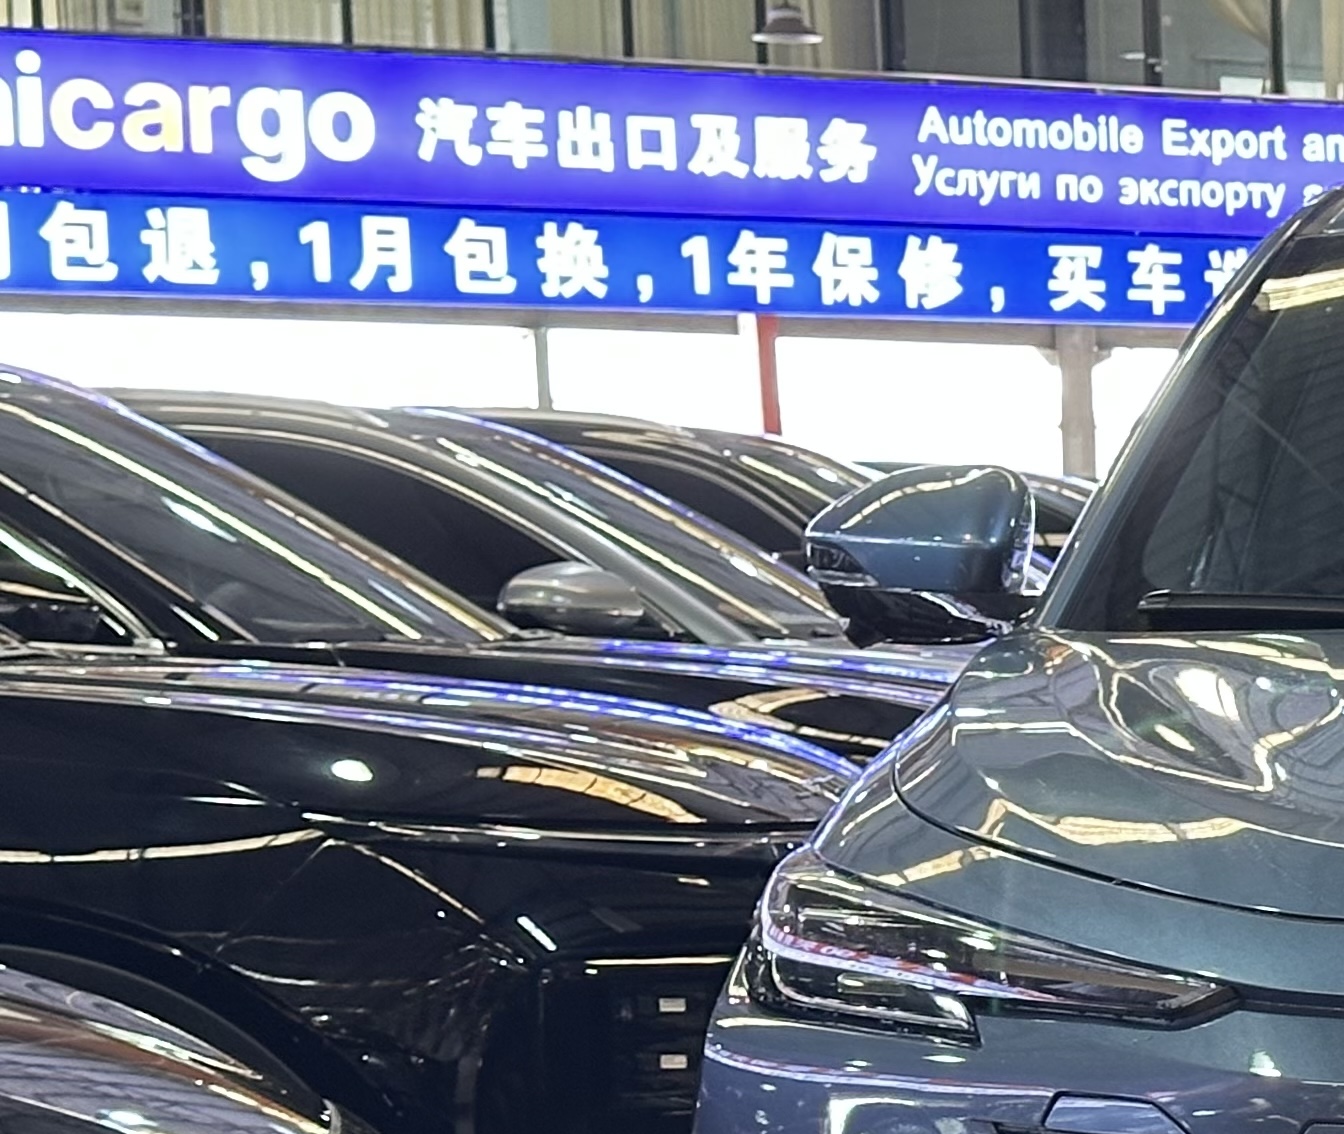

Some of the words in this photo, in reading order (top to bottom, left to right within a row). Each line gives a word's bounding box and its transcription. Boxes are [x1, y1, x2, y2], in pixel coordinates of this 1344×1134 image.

[0, 49, 376, 182] icargo
[415, 97, 877, 183] 汽车出口及服务
[916, 105, 1144, 155] Automobile
[1161, 118, 1288, 166] Export
[911, 153, 1041, 206] Услуги
[1055, 173, 1104, 203] по
[1117, 176, 1287, 218] экспорту
[0, 200, 1249, 316] 包退，1月包换，1年保修，买车
